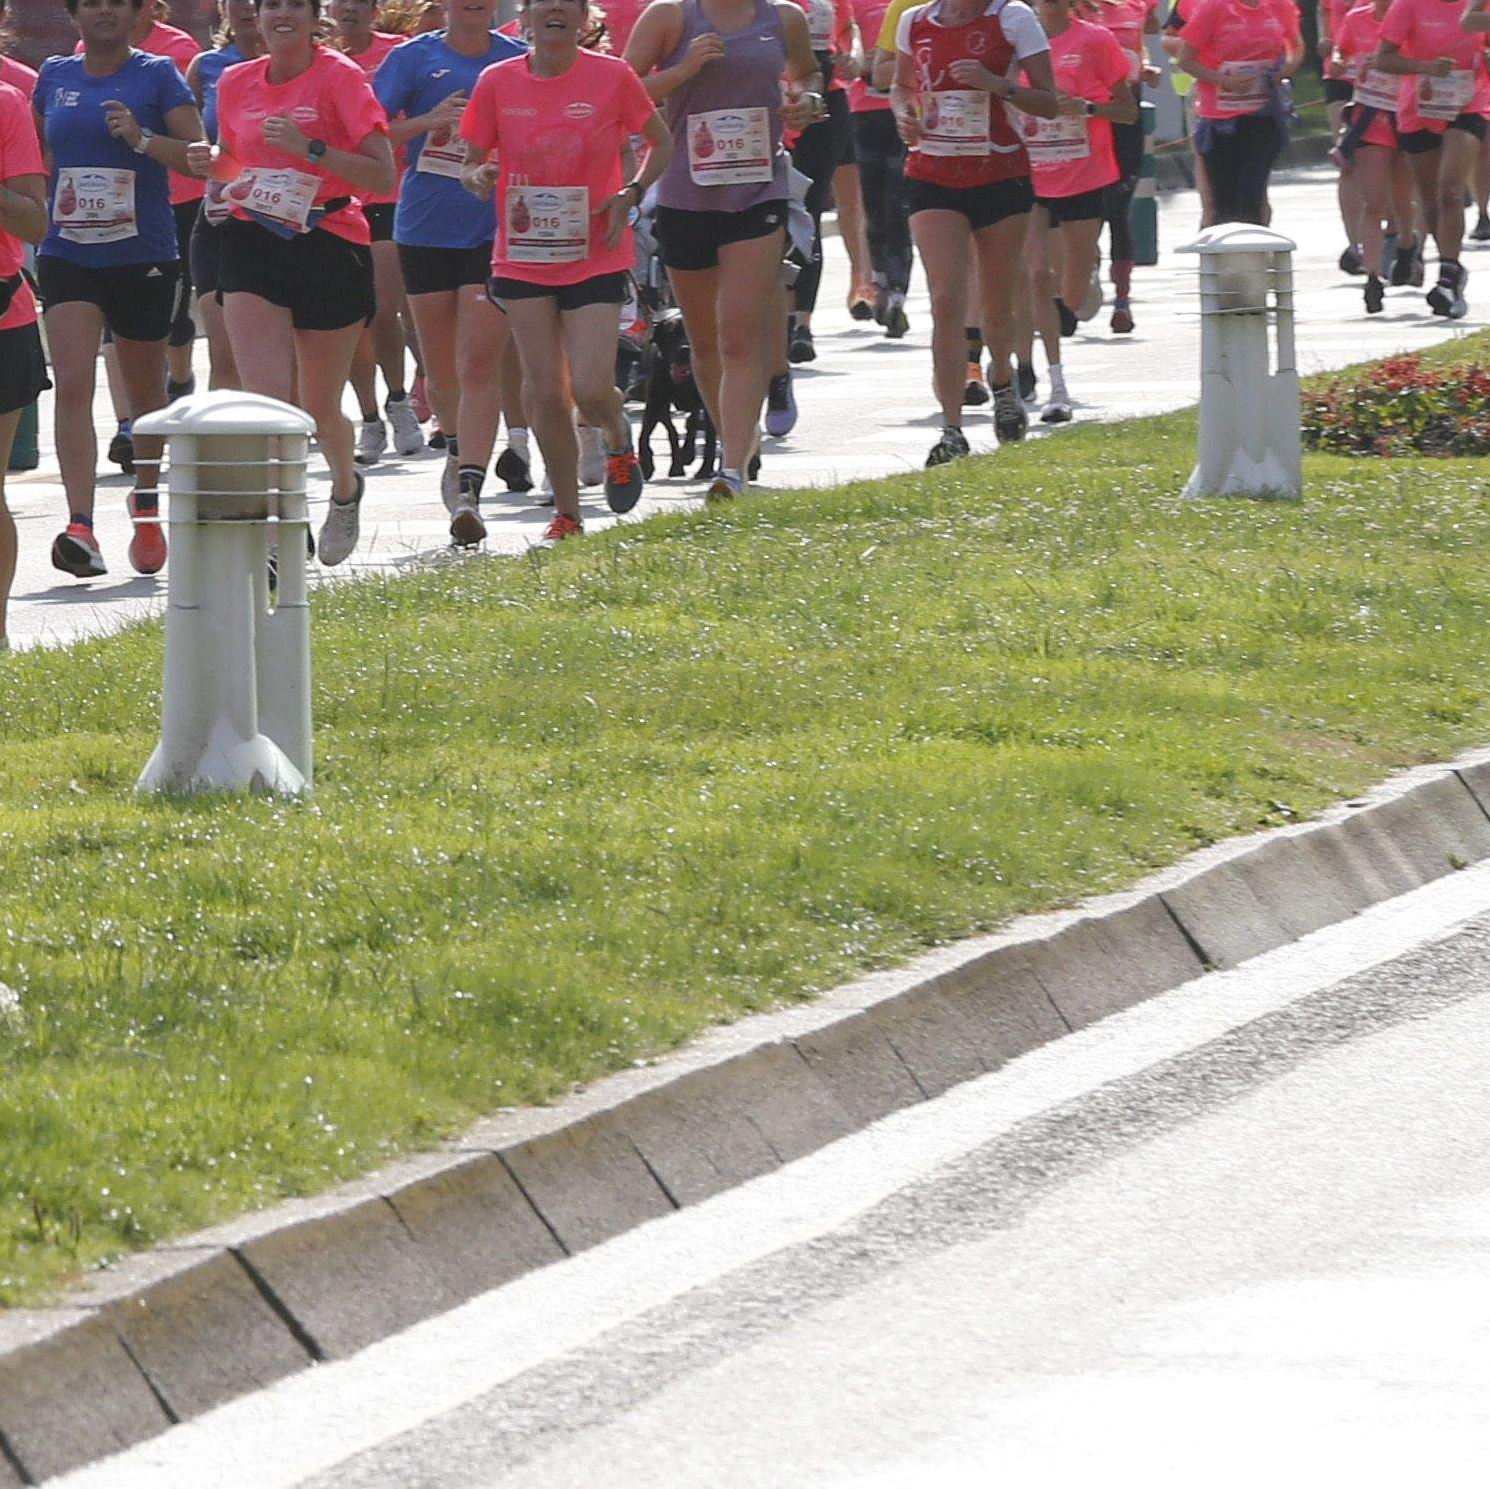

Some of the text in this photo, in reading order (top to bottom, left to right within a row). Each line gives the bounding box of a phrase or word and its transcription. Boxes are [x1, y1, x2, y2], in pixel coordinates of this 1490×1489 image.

[717, 138, 745, 150] 016
[253, 188, 282, 203] 016
[79, 198, 105, 209] 016
[533, 217, 560, 228] 016
